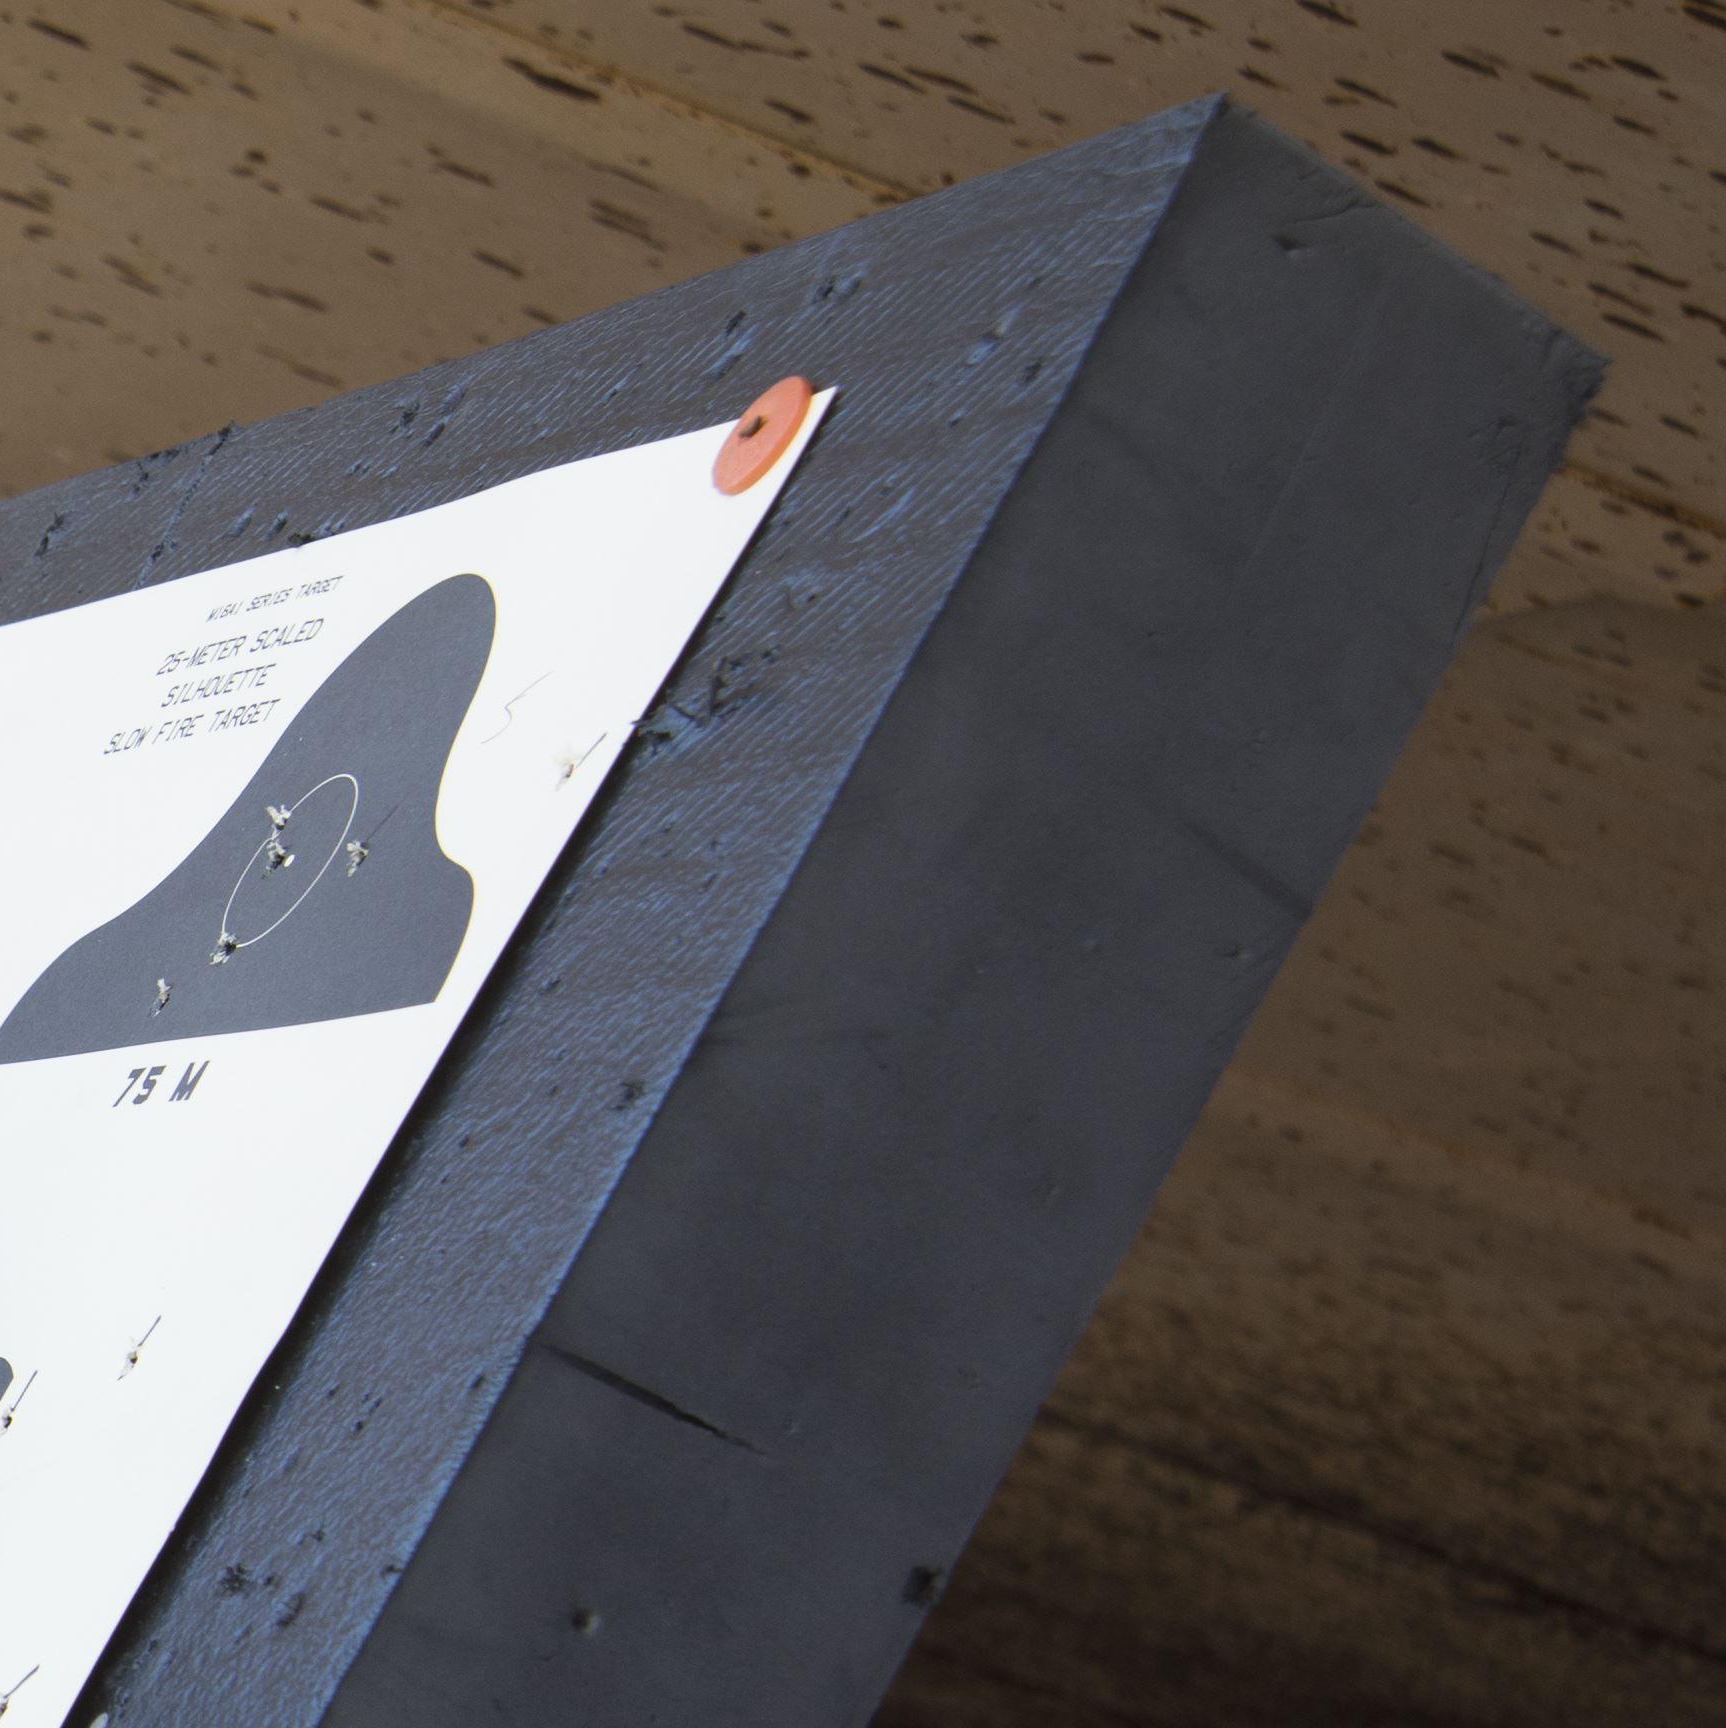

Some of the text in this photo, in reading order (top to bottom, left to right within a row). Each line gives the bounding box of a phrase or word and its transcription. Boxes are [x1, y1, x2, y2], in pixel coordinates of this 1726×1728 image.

[246, 588, 293, 611] SERIES
[296, 575, 344, 599] TARGET
[156, 618, 324, 676] 25-METER SCALED
[161, 663, 276, 708] SILHOUETTE
[104, 698, 281, 755] SLOW FIRE TARGET
[112, 1060, 210, 1108] 75 M
